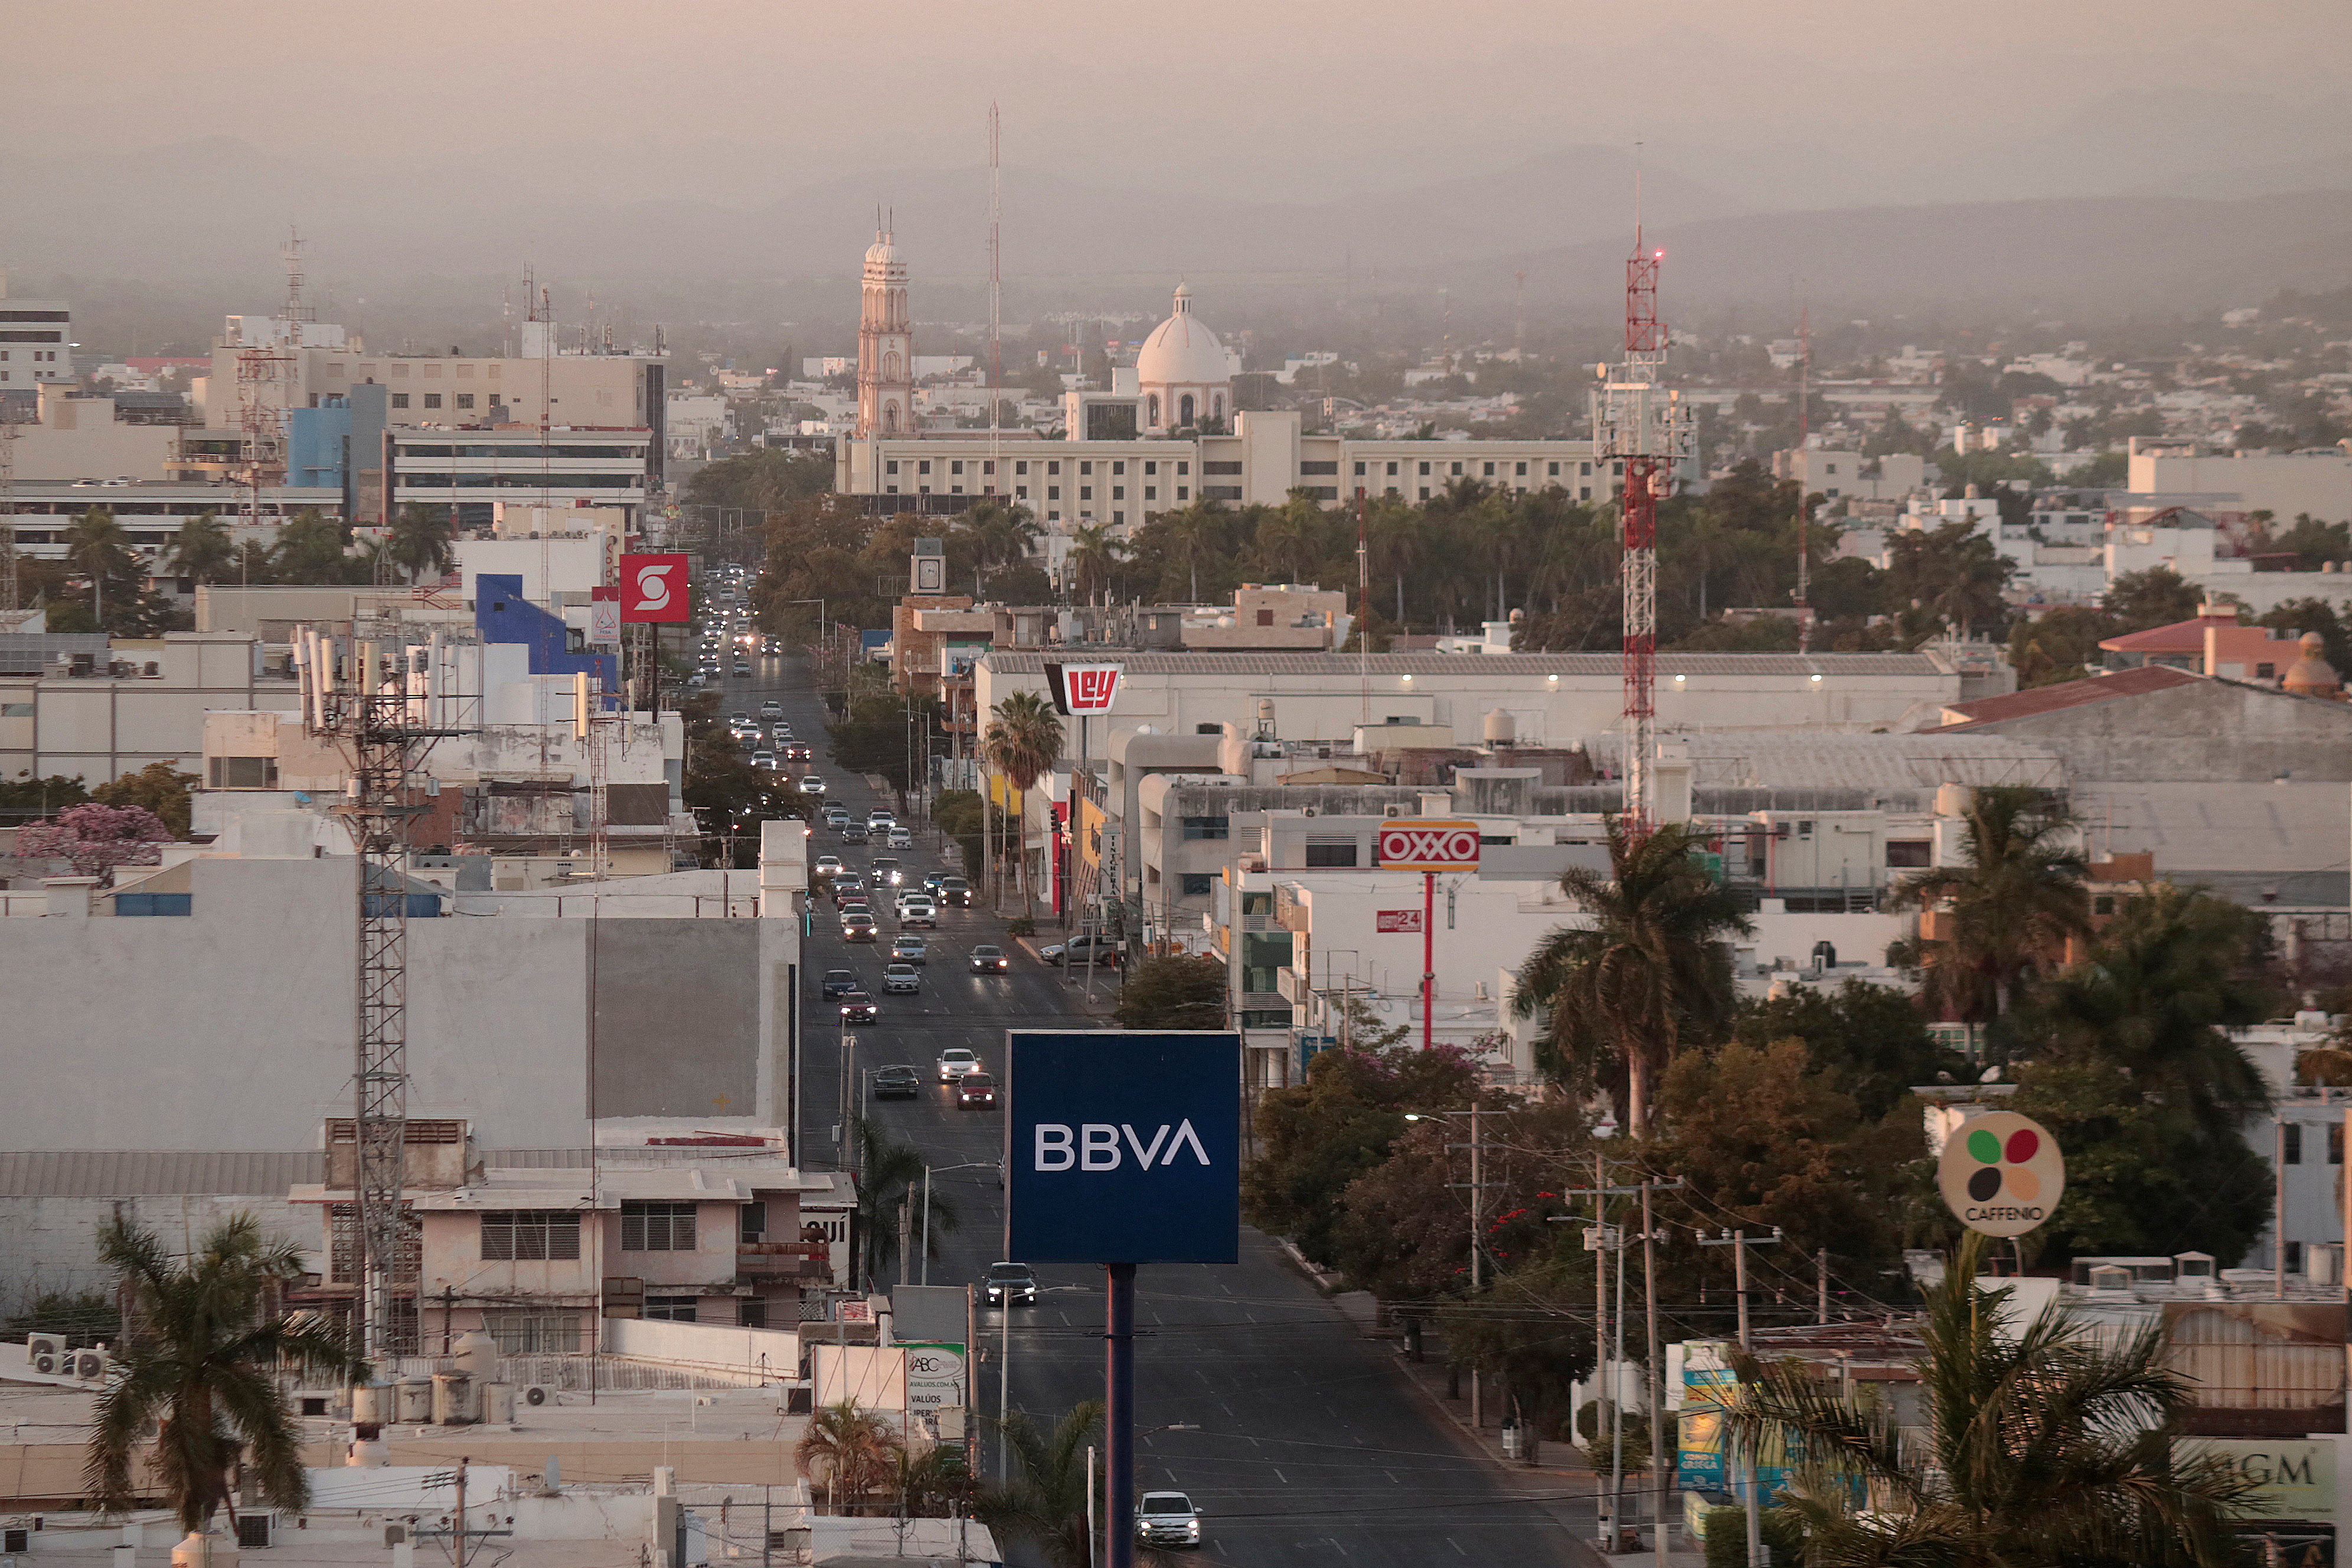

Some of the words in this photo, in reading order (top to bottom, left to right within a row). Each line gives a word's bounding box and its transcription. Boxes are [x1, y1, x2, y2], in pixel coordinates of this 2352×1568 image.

[1383, 831, 1476, 860] OXXO
[1399, 913, 1419, 925] 24
[1035, 1118, 1211, 1171] BBVA
[1965, 1207, 2044, 1221] CAFFENIO
[912, 1357, 939, 1372] ABC
